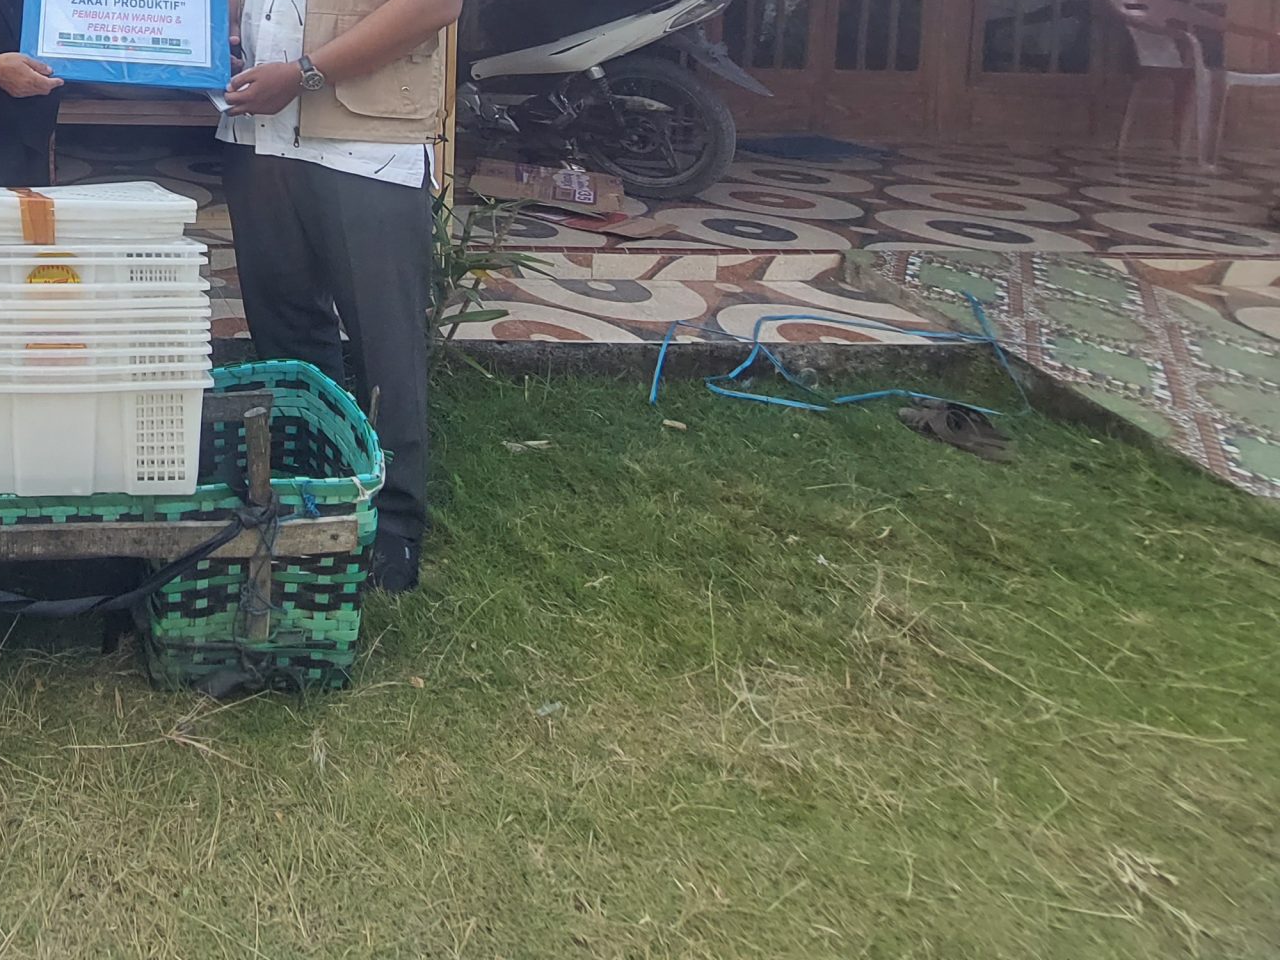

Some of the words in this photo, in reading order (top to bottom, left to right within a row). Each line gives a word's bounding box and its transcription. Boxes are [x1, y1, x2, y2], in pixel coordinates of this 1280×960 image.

[72, 9, 129, 21] PEMBUATAN
[131, 12, 173, 24] WARUNG
[175, 16, 182, 24] &
[87, 23, 164, 36] PERLENGKAPAN
